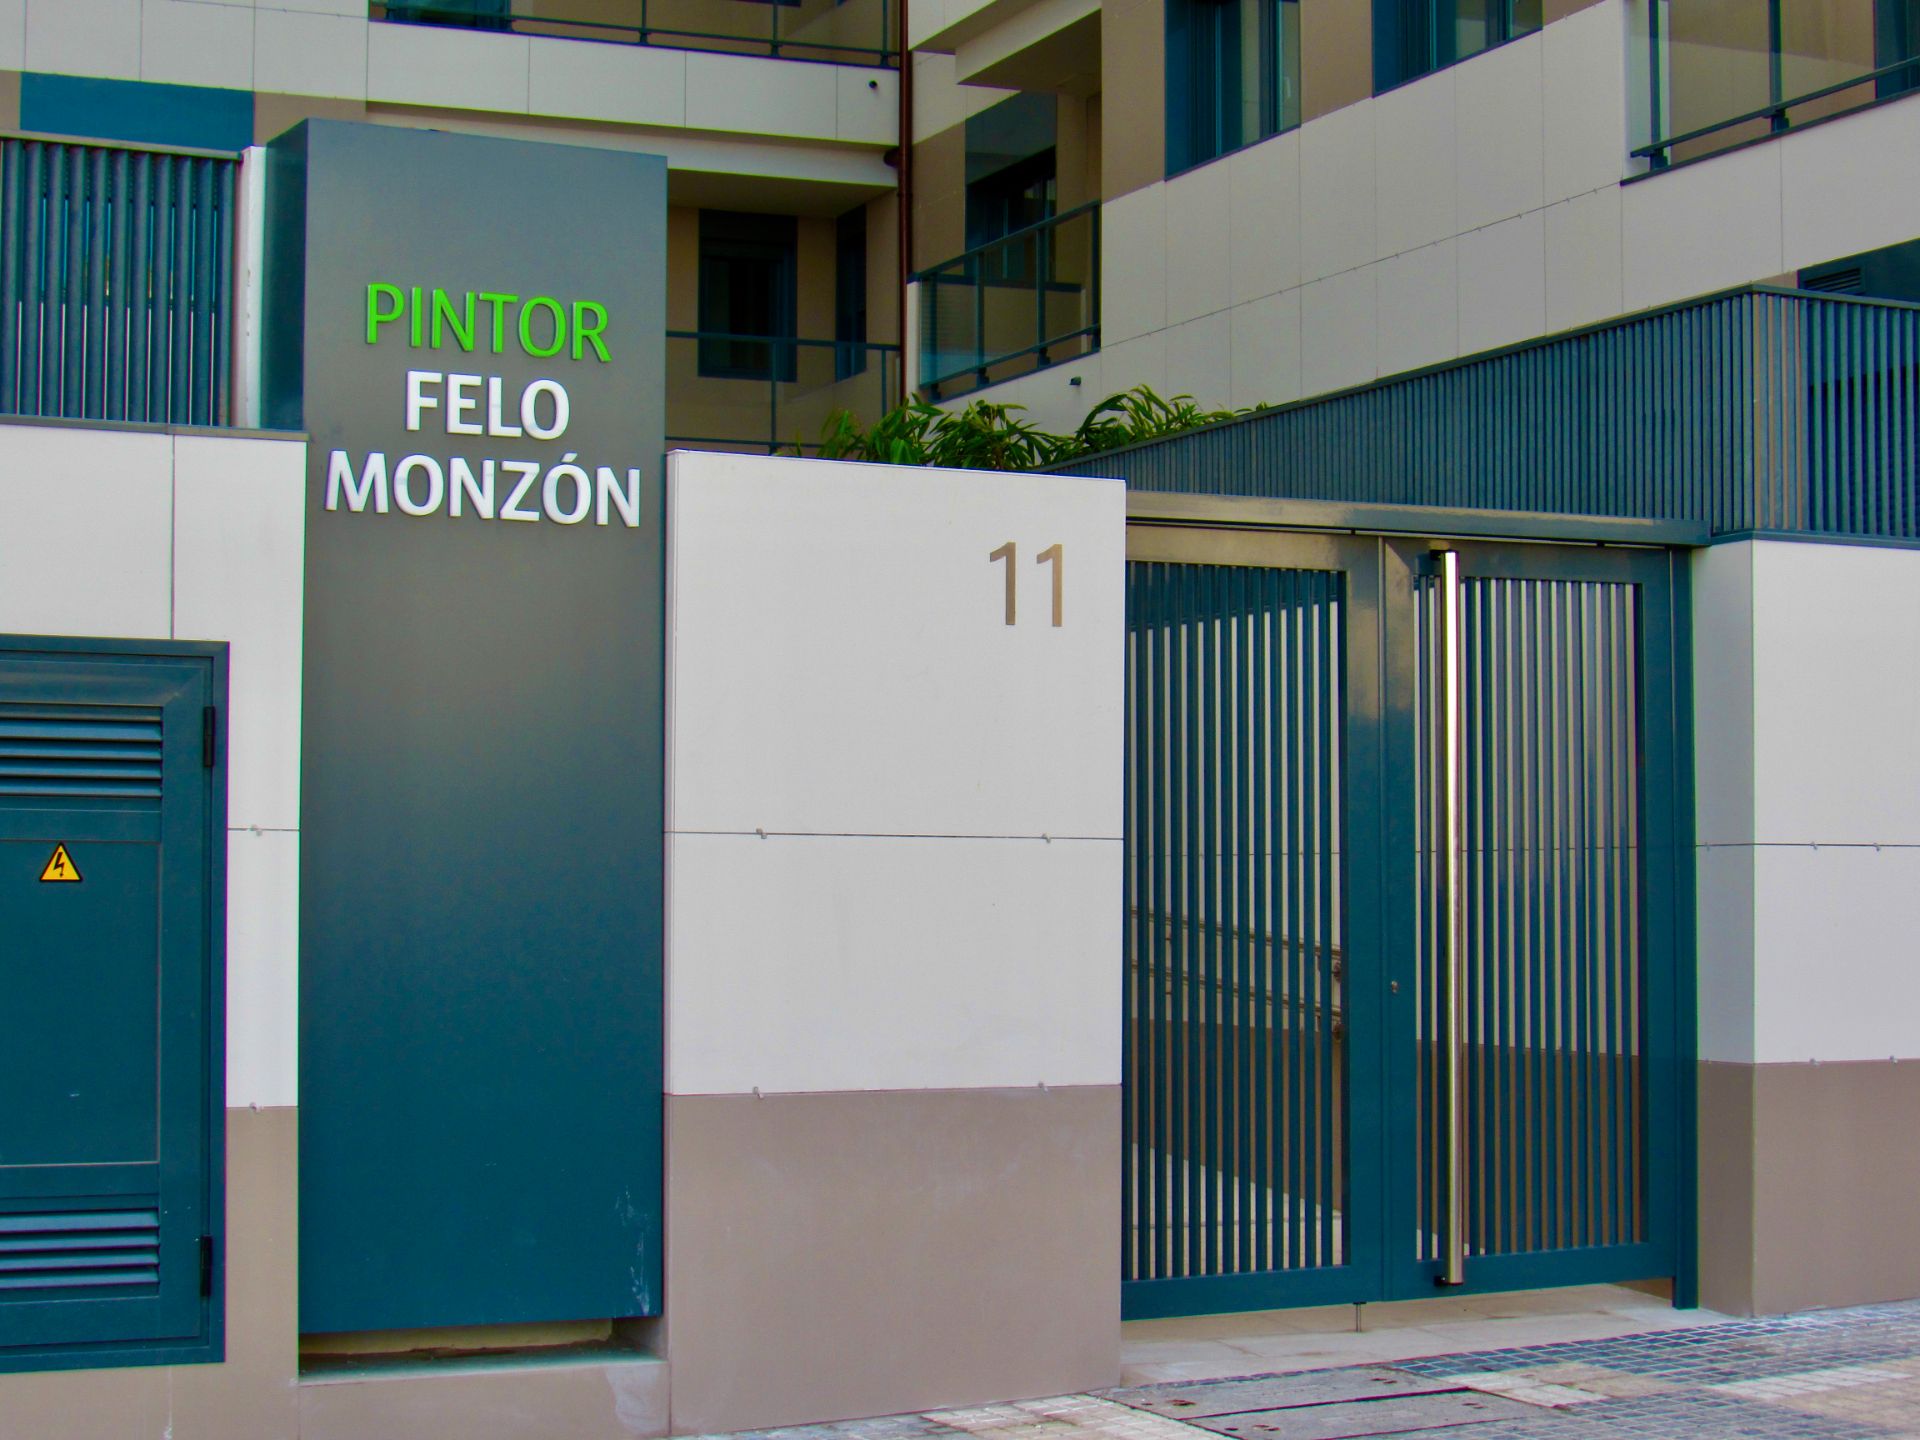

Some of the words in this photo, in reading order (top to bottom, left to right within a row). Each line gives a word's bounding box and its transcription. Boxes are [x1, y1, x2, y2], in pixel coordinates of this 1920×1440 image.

[365, 282, 612, 363] PINTOR
[405, 370, 570, 441] FELO
[325, 449, 641, 528] MONZÓN
[989, 541, 1063, 628] 11
